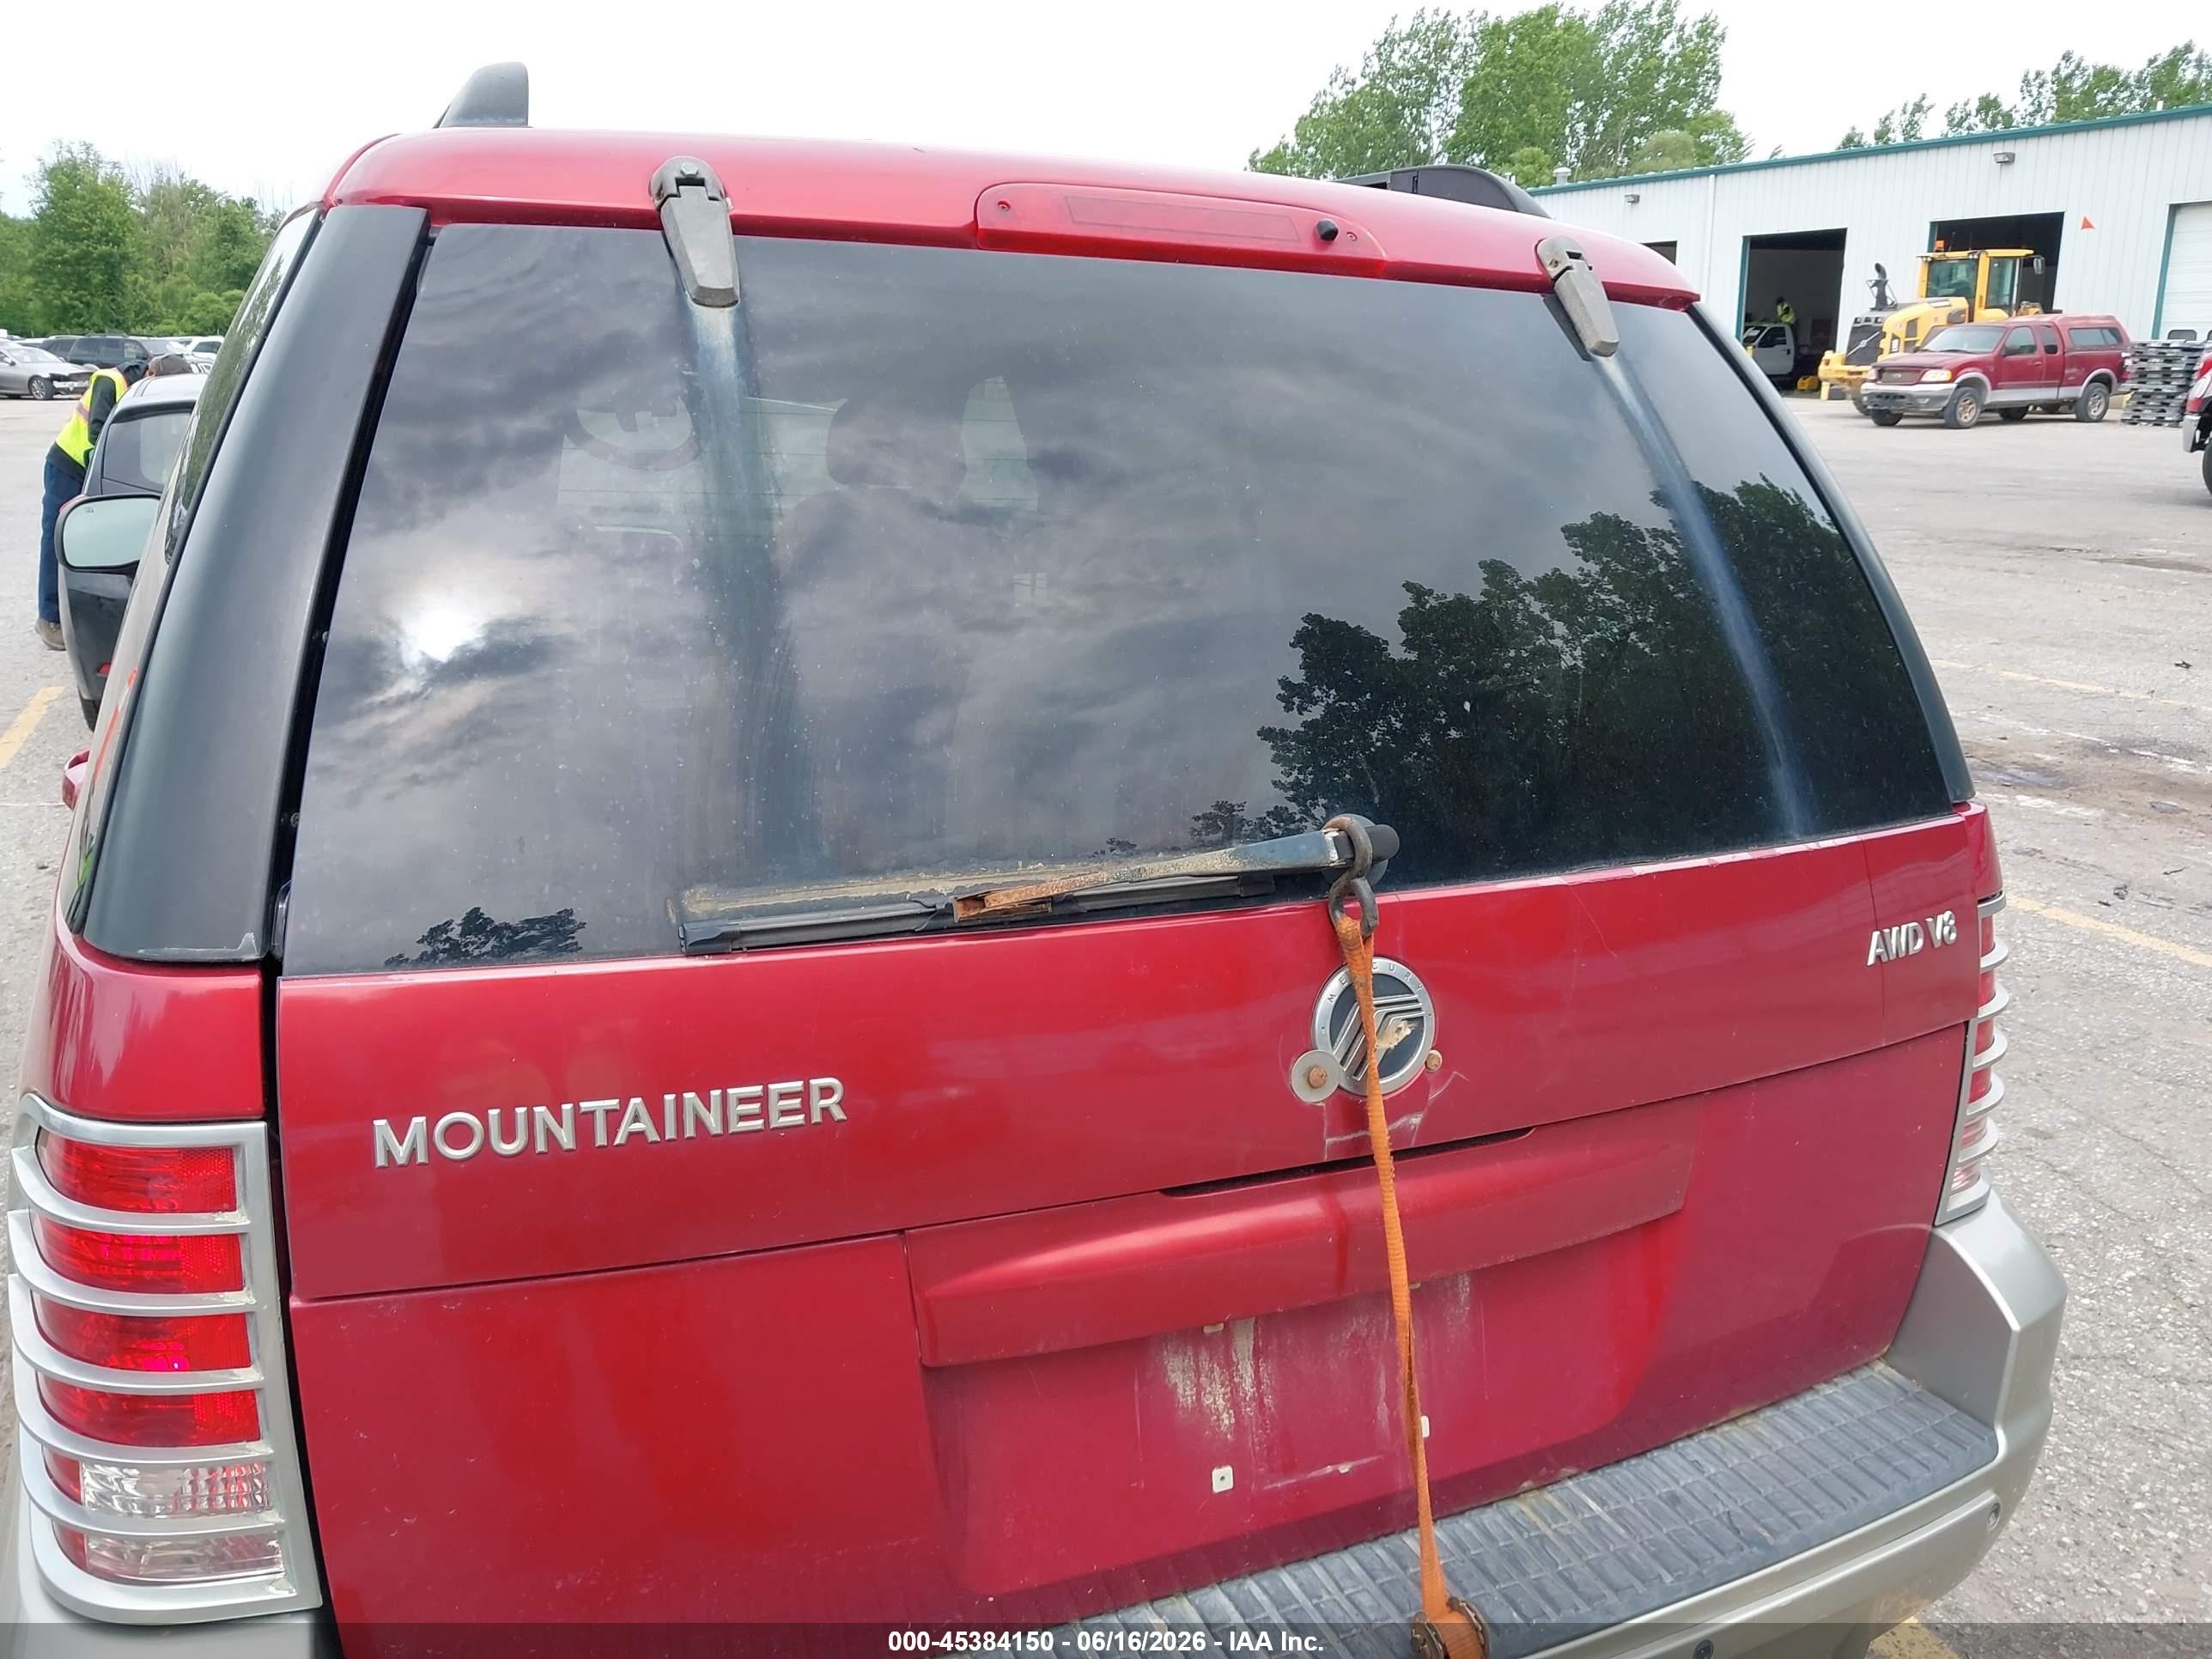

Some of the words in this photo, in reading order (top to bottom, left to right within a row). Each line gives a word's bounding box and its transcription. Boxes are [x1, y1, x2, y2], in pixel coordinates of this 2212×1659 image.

[1867, 921, 1924, 966] AWD
[1924, 910, 1958, 949] V8
[1326, 961, 1423, 1004] MECURY
[372, 1076, 848, 1168] MOUNTAINEER
